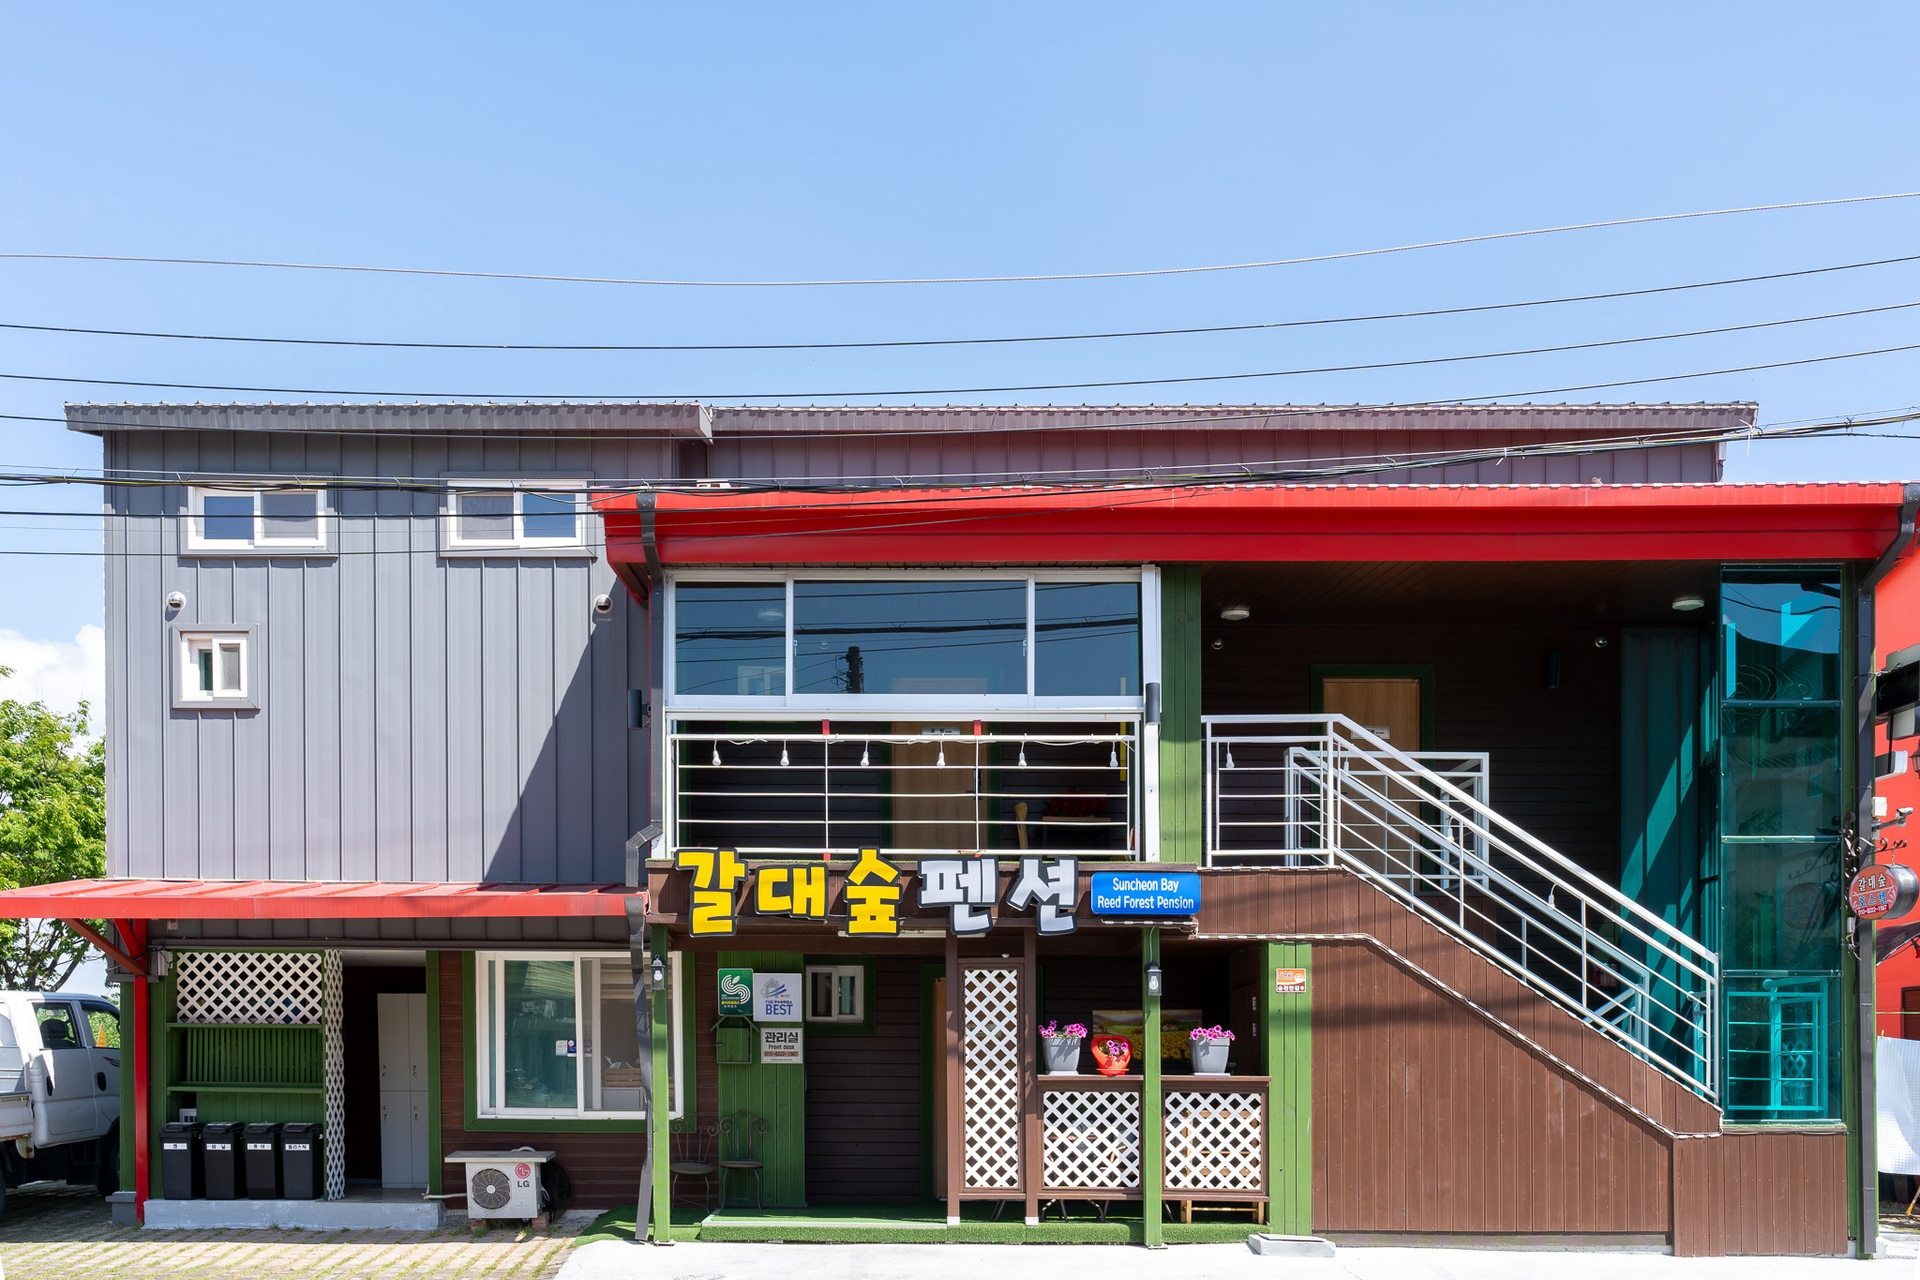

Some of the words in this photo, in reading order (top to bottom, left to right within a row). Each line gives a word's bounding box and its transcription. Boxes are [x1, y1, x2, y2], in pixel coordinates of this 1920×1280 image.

[1112, 878, 1158, 891] Suncheon
[1161, 878, 1179, 893] Bay
[1858, 873, 1886, 891] 갈대숲
[1097, 895, 1121, 908] Reed
[1124, 895, 1155, 908] Forest
[1157, 895, 1194, 908] Pension
[1858, 890, 1887, 908] 호스텔
[765, 1004, 793, 1015] BEST
[765, 1032, 798, 1043] 관리실
[517, 1180, 530, 1188] LG
